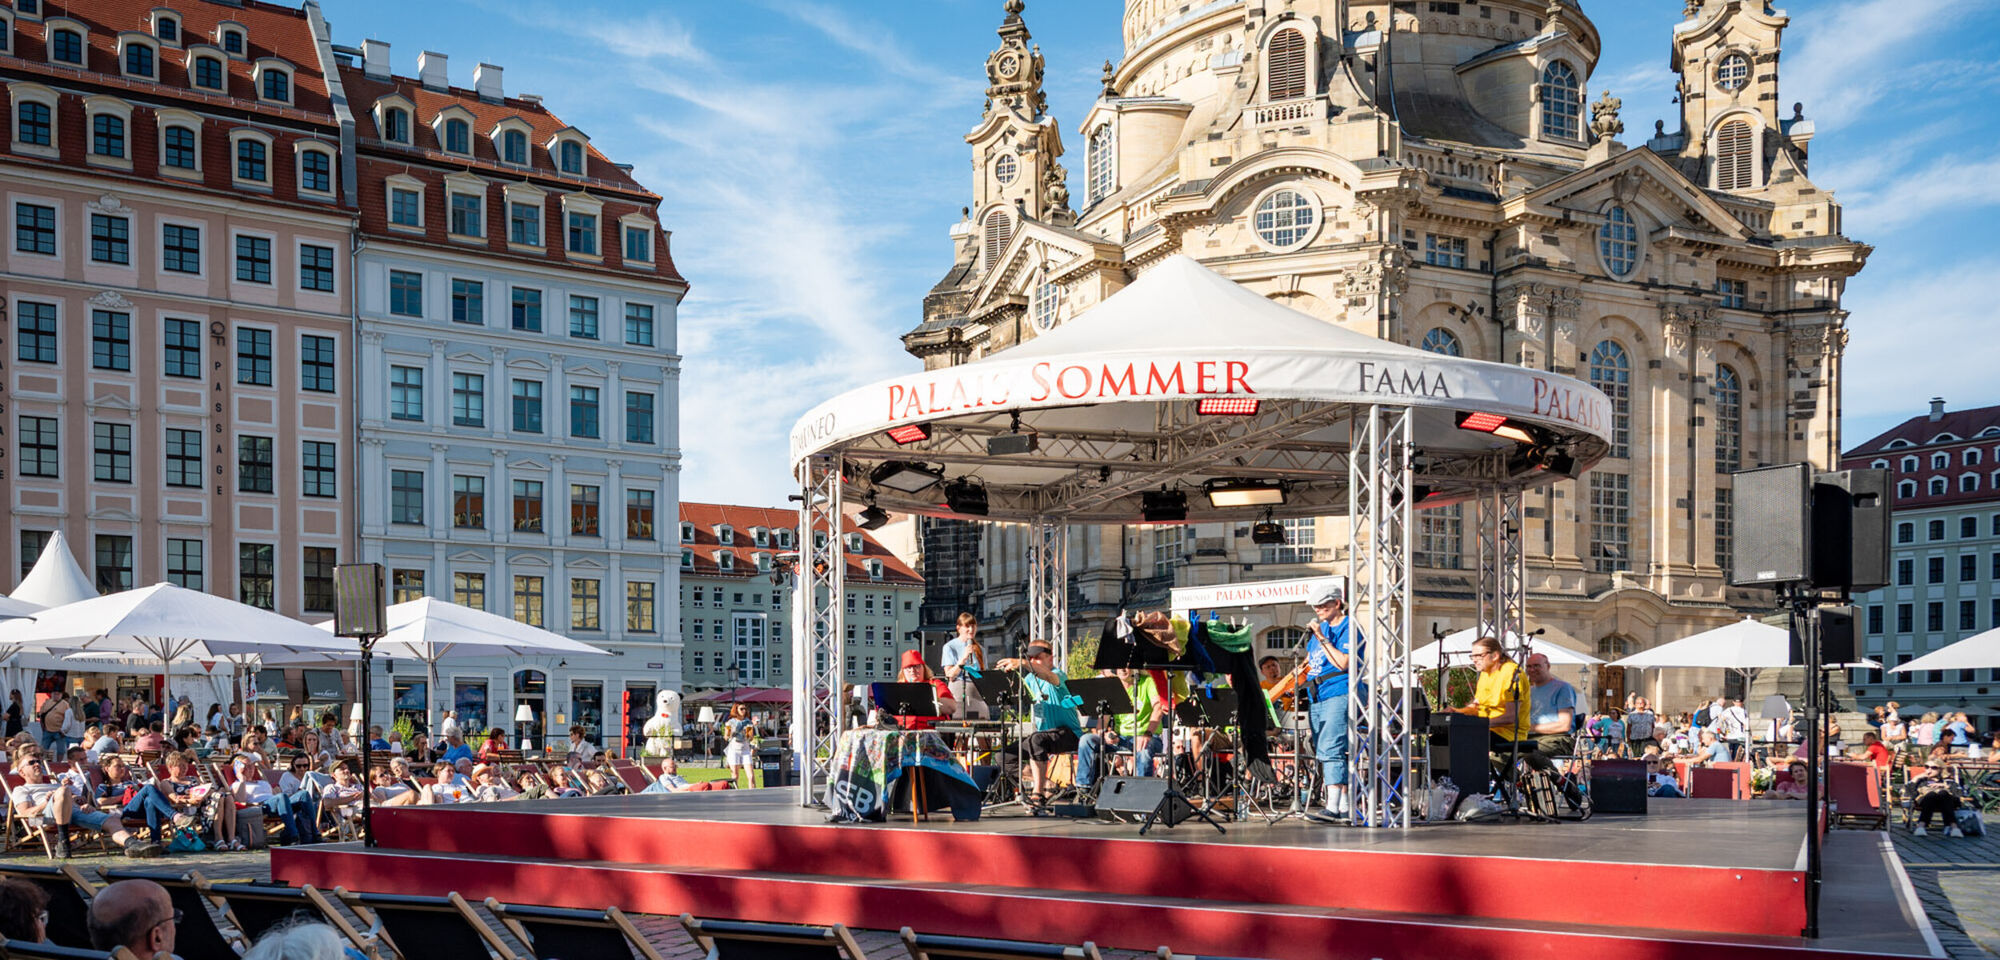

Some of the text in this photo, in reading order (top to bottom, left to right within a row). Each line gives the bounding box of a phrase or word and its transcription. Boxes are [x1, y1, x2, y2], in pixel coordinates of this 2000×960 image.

[888, 361, 1257, 421] PALAIS SOMMER
[1357, 361, 1452, 398] FAMA
[1530, 377, 1601, 431] PALAIS
[214, 361, 223, 495] PASSAGE
[1216, 589, 1253, 601] PALAIS
[1257, 584, 1310, 597] SOMMER
